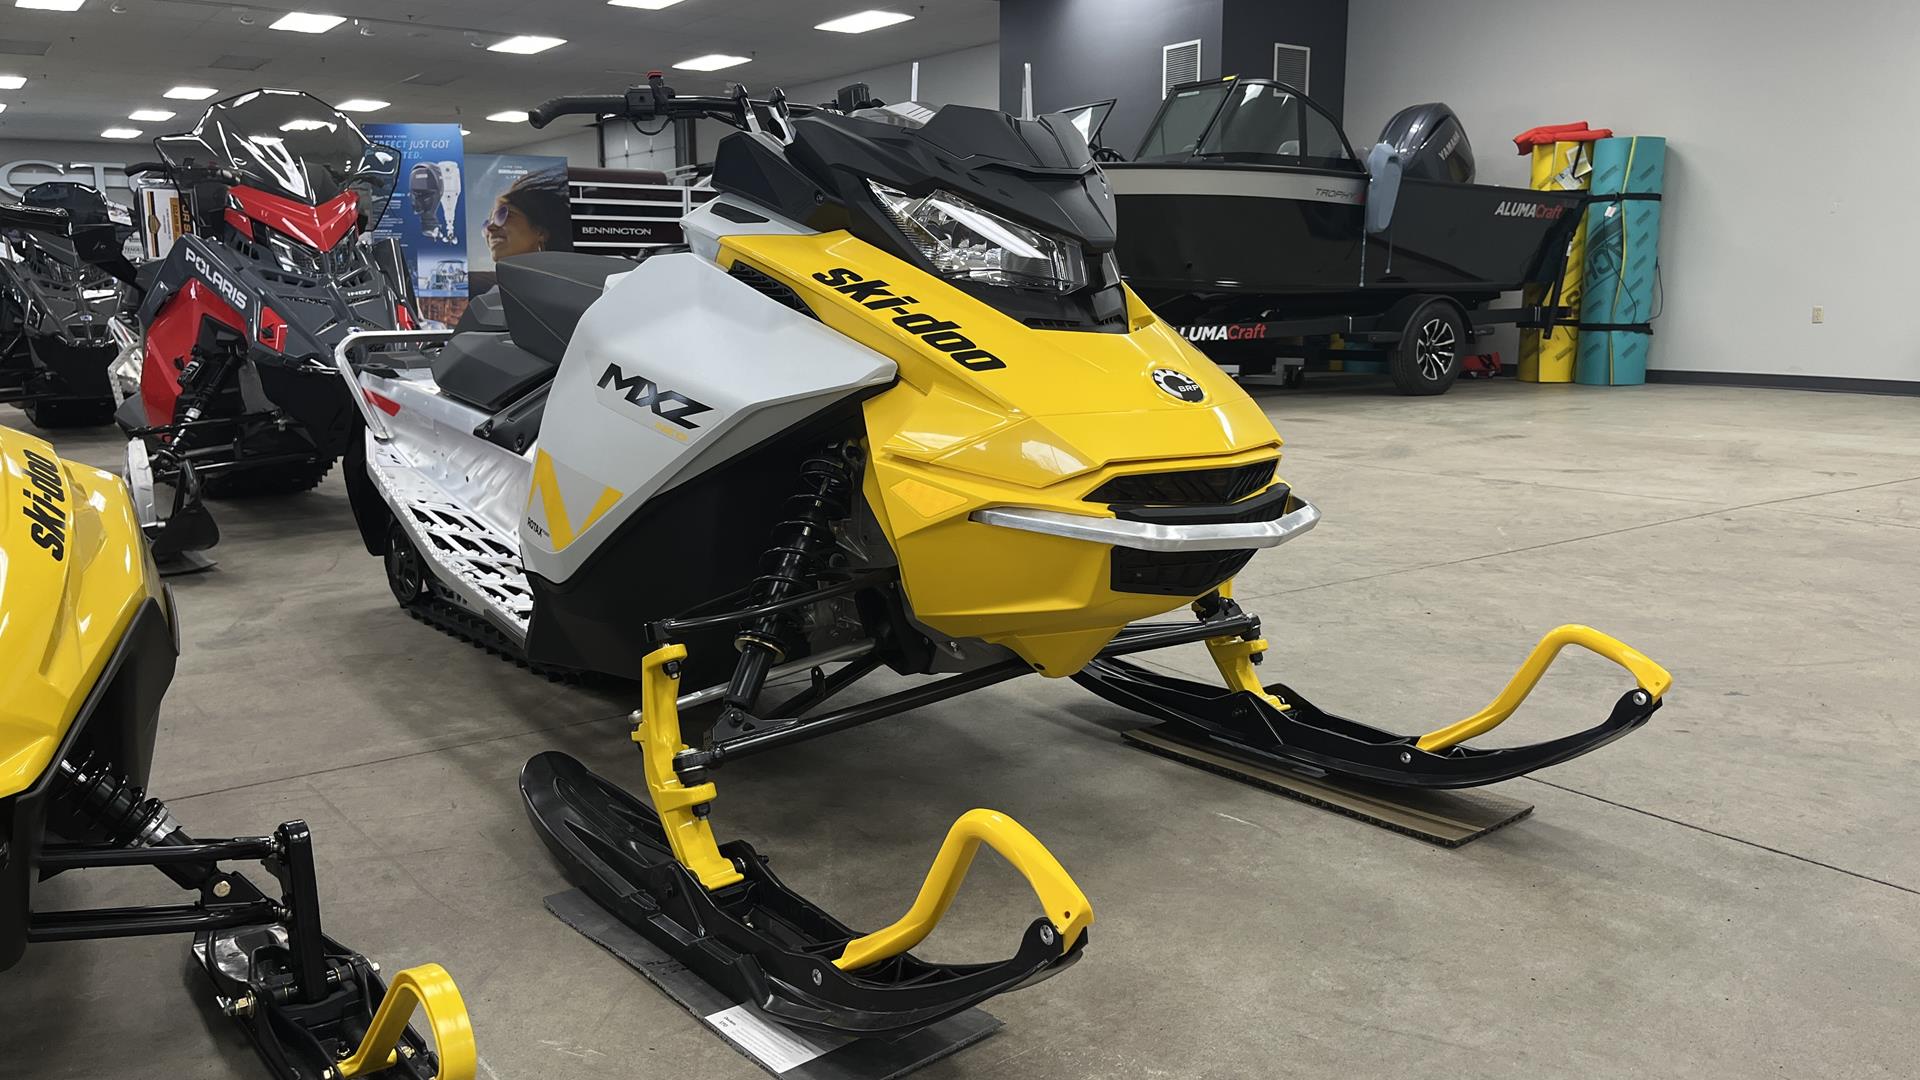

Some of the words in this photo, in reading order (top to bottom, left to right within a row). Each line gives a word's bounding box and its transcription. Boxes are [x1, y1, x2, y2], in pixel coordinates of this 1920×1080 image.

[409, 140, 430, 151] JUST
[431, 140, 449, 149] GOT
[1494, 200, 1564, 219] ALUMACraft
[582, 226, 652, 236] BENNINGTON
[185, 247, 248, 310] POLARIS
[812, 267, 1007, 372] ski-doo
[1175, 323, 1266, 341] LUMACraft
[597, 362, 715, 430] MXZ
[1178, 384, 1199, 392] BRP
[23, 449, 66, 562] ski-doo
[527, 516, 543, 538] ROTAX
